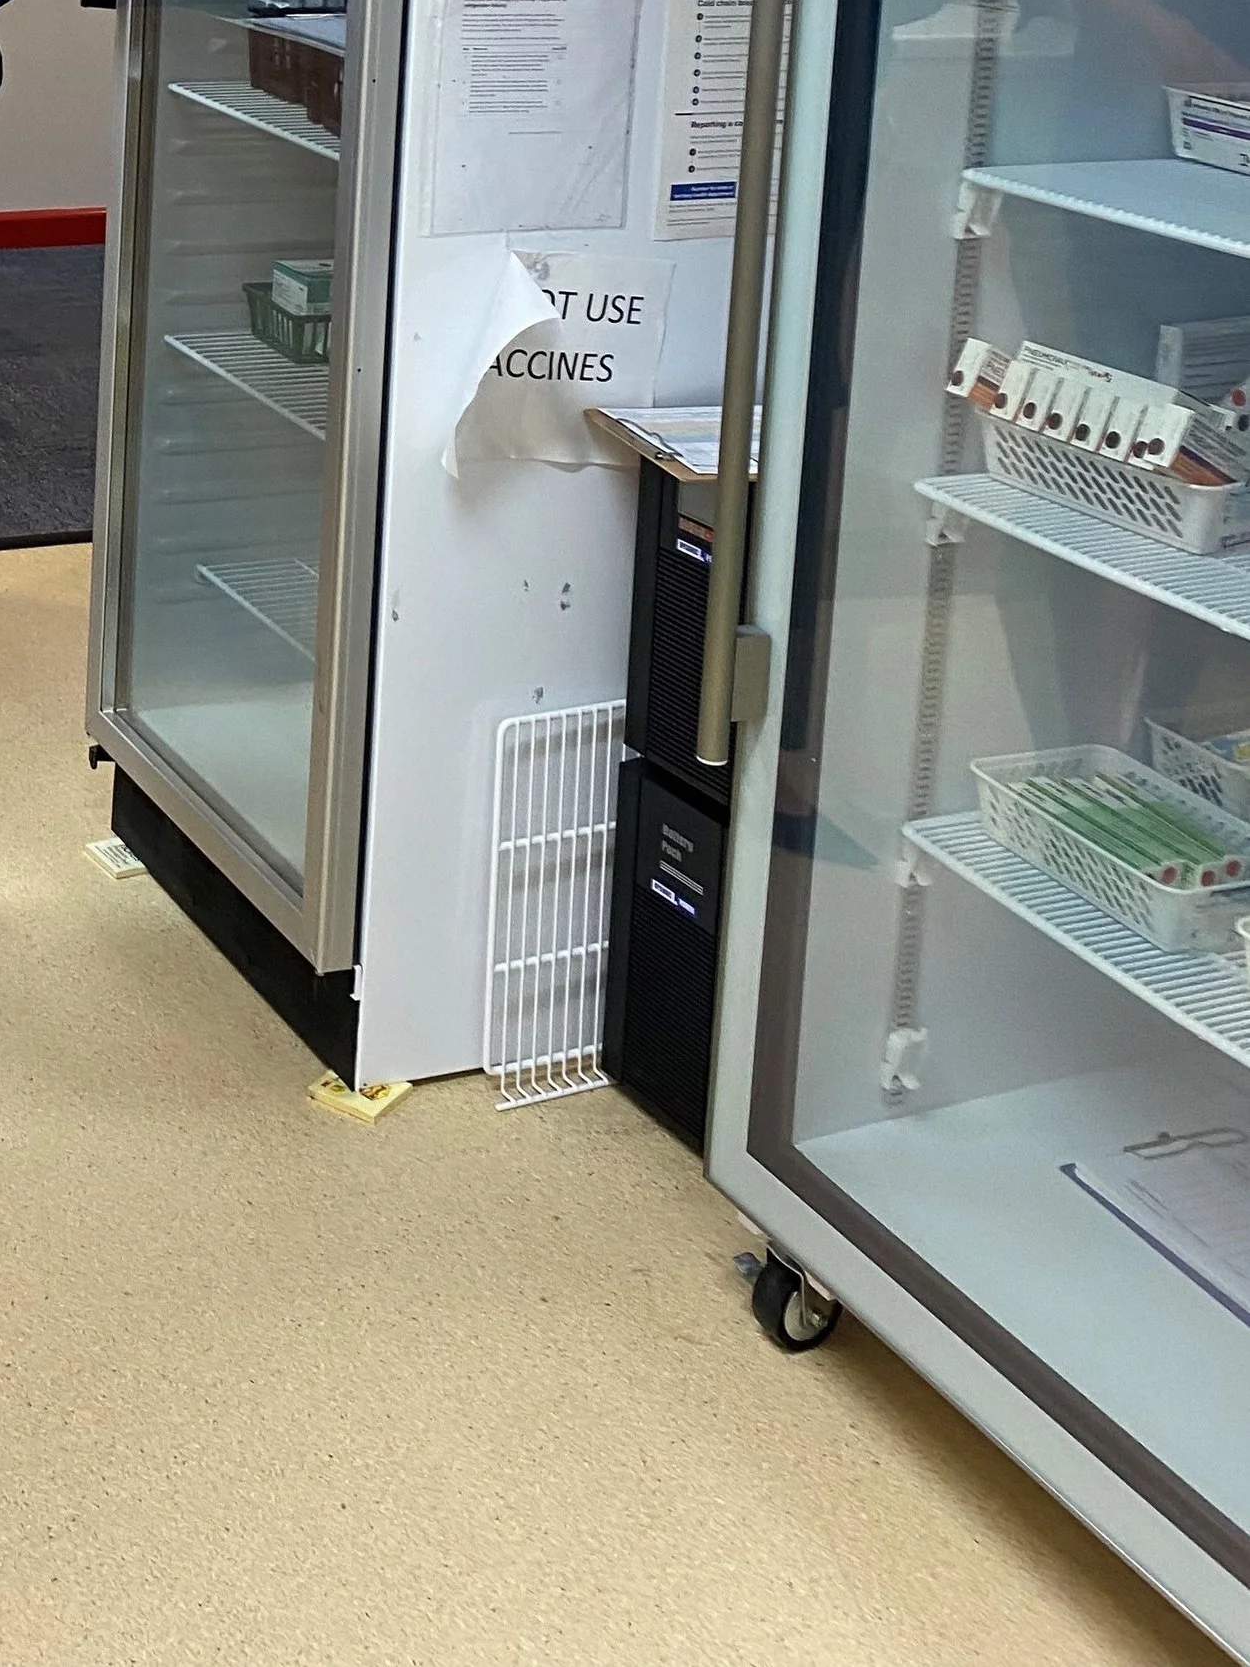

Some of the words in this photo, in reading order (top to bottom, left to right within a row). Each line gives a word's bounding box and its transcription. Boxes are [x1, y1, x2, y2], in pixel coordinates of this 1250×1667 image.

[691, 121, 726, 129] Reporting
[586, 293, 645, 325] USE
[662, 823, 694, 852] Battery
